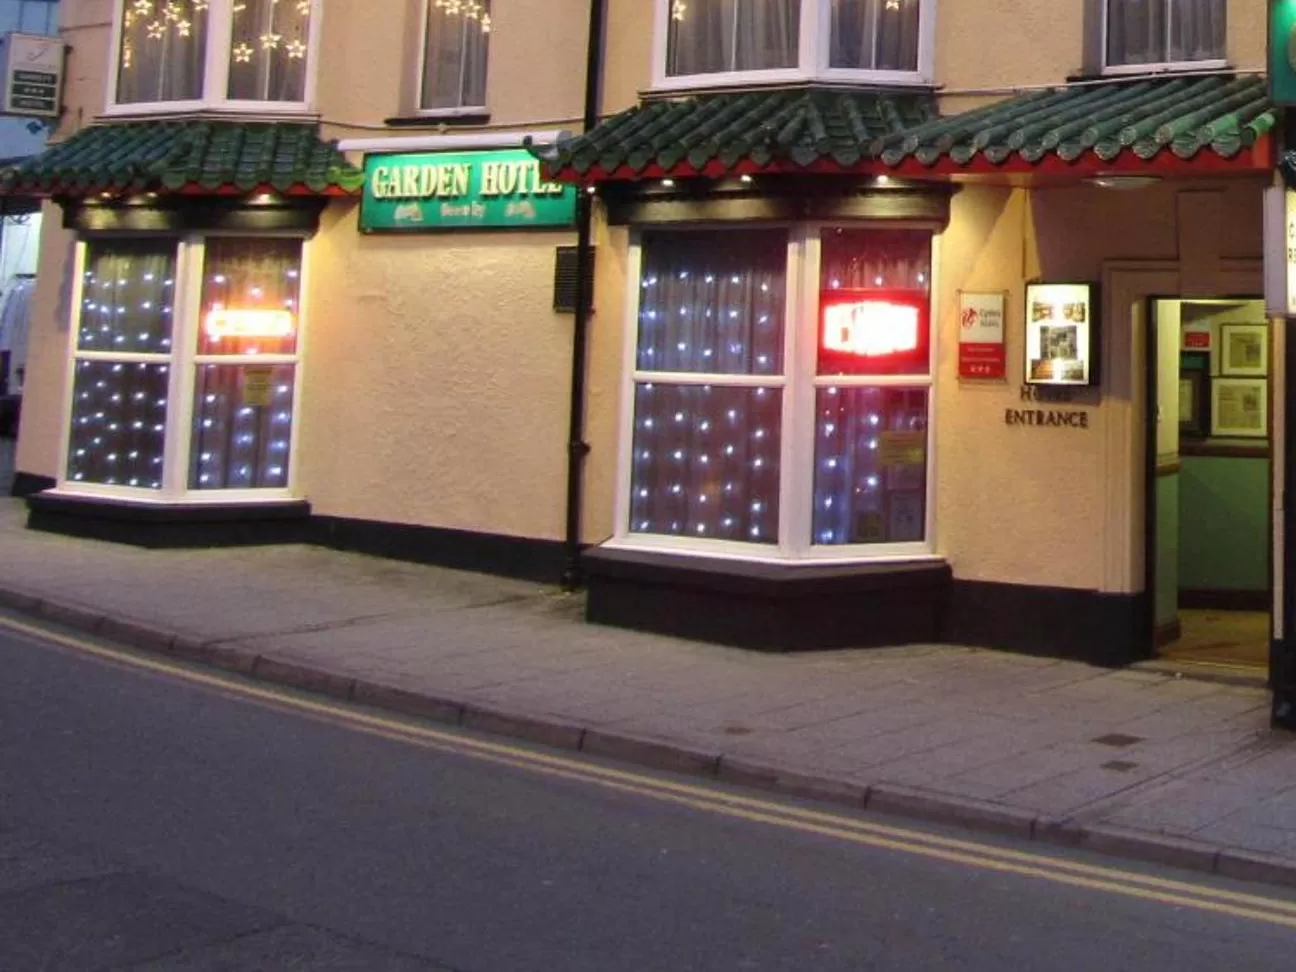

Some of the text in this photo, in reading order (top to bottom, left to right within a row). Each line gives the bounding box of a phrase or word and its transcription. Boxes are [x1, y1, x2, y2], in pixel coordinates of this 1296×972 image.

[371, 159, 564, 199] GARDEN HOTE
[1004, 408, 1089, 429] ENTRANCE
